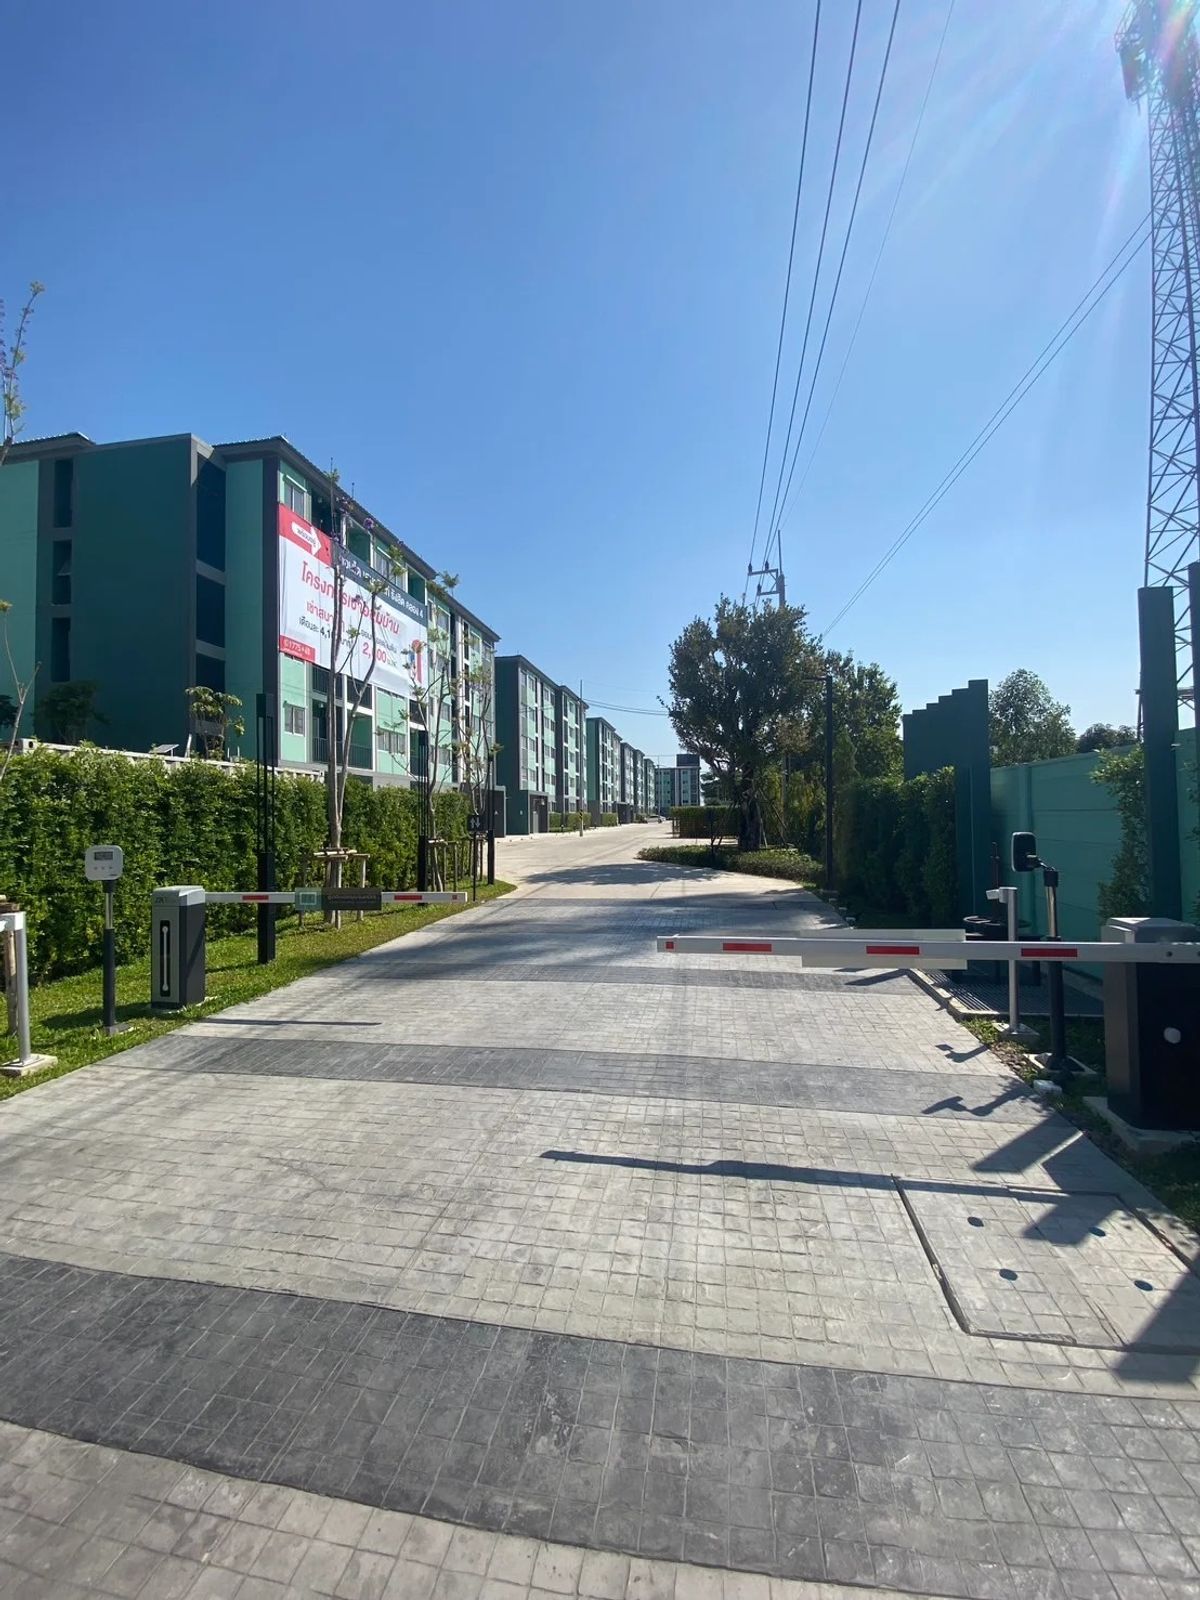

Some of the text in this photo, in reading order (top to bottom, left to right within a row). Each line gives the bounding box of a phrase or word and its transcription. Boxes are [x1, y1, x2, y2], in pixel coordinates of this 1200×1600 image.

[302, 560, 400, 634] โครงกรเชาอมบ้าน
[419, 609, 424, 619] 4
[362, 642, 387, 663] 2,00
